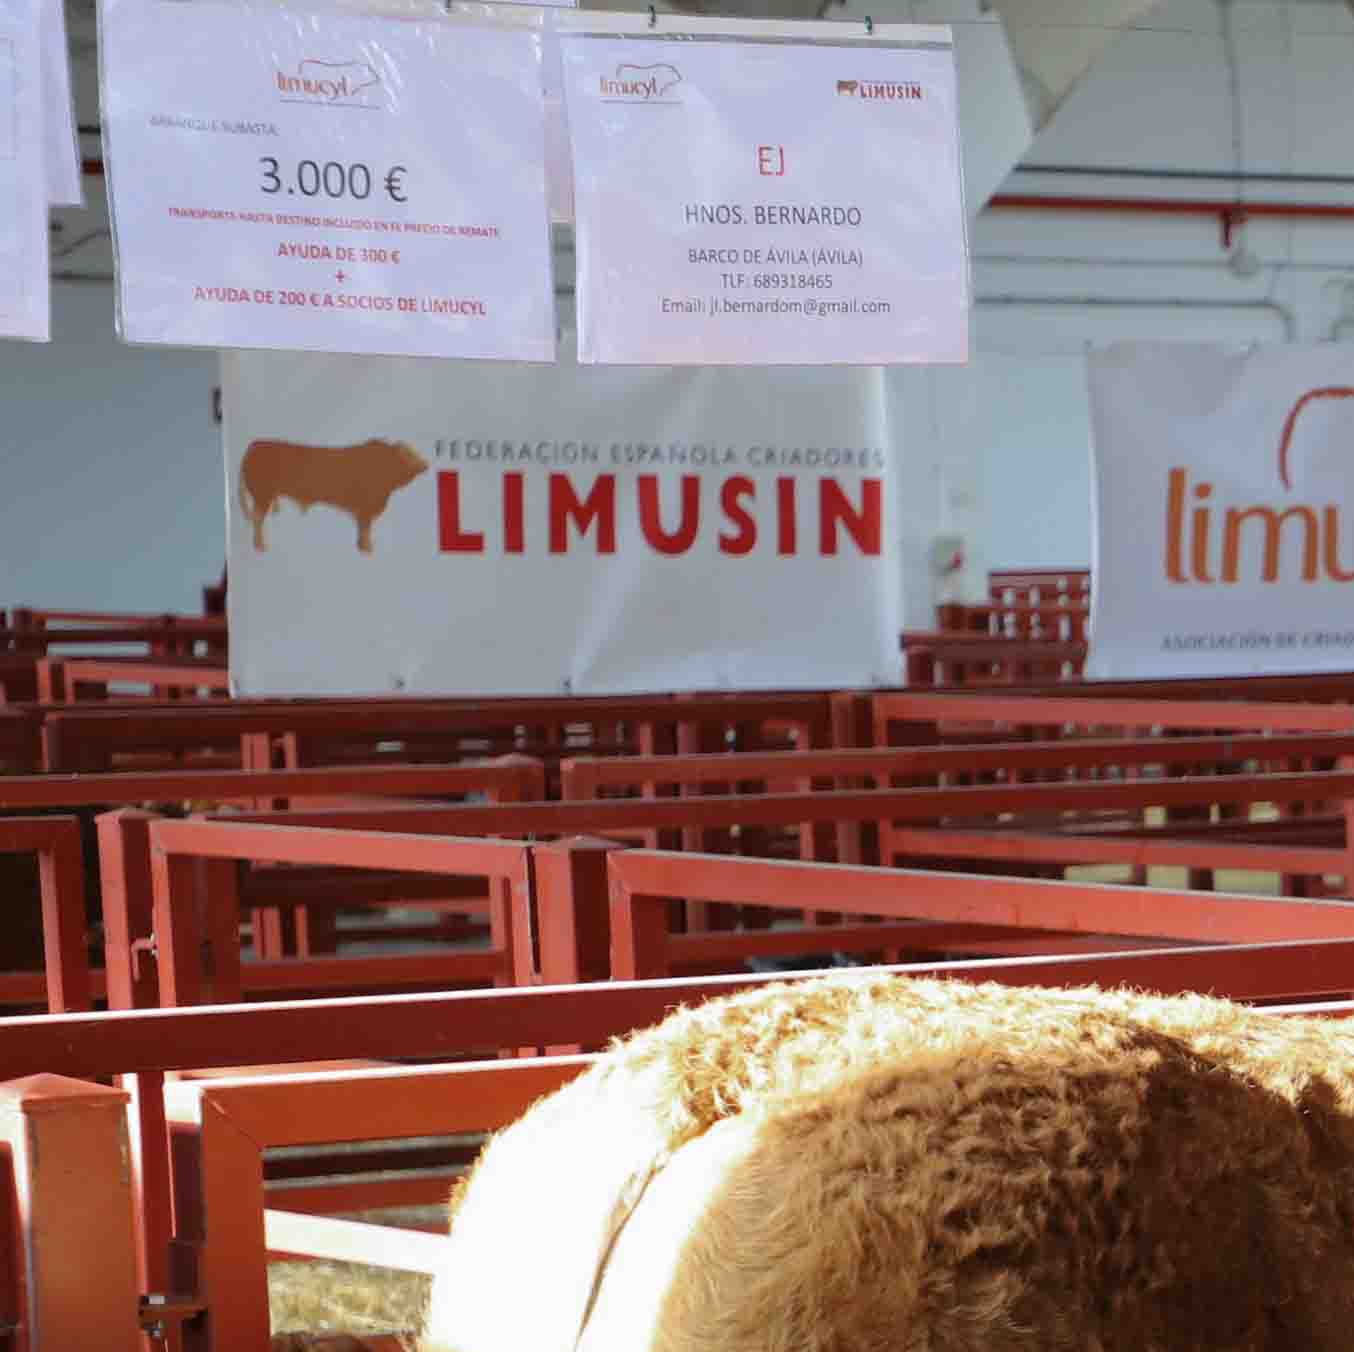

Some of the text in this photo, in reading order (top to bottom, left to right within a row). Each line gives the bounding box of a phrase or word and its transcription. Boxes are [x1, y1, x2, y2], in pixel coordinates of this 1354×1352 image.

[600, 76, 657, 99] limucyl
[860, 84, 921, 99] LIMUSIN
[758, 145, 784, 177] EJ
[259, 156, 408, 202] 3.000 €
[685, 205, 862, 226] HNOS. BERNARDO
[277, 242, 401, 264] AYUDA DE 300 €
[688, 245, 864, 267] BARCO DE ÁVILA (ÁVILA)
[753, 273, 833, 290] 689318465
[193, 286, 488, 316] AYUDA DE 200 € A SOCIOS DE LIMUCYL
[747, 447, 883, 467] CRIADORES
[437, 470, 882, 556] LIMUSIN
